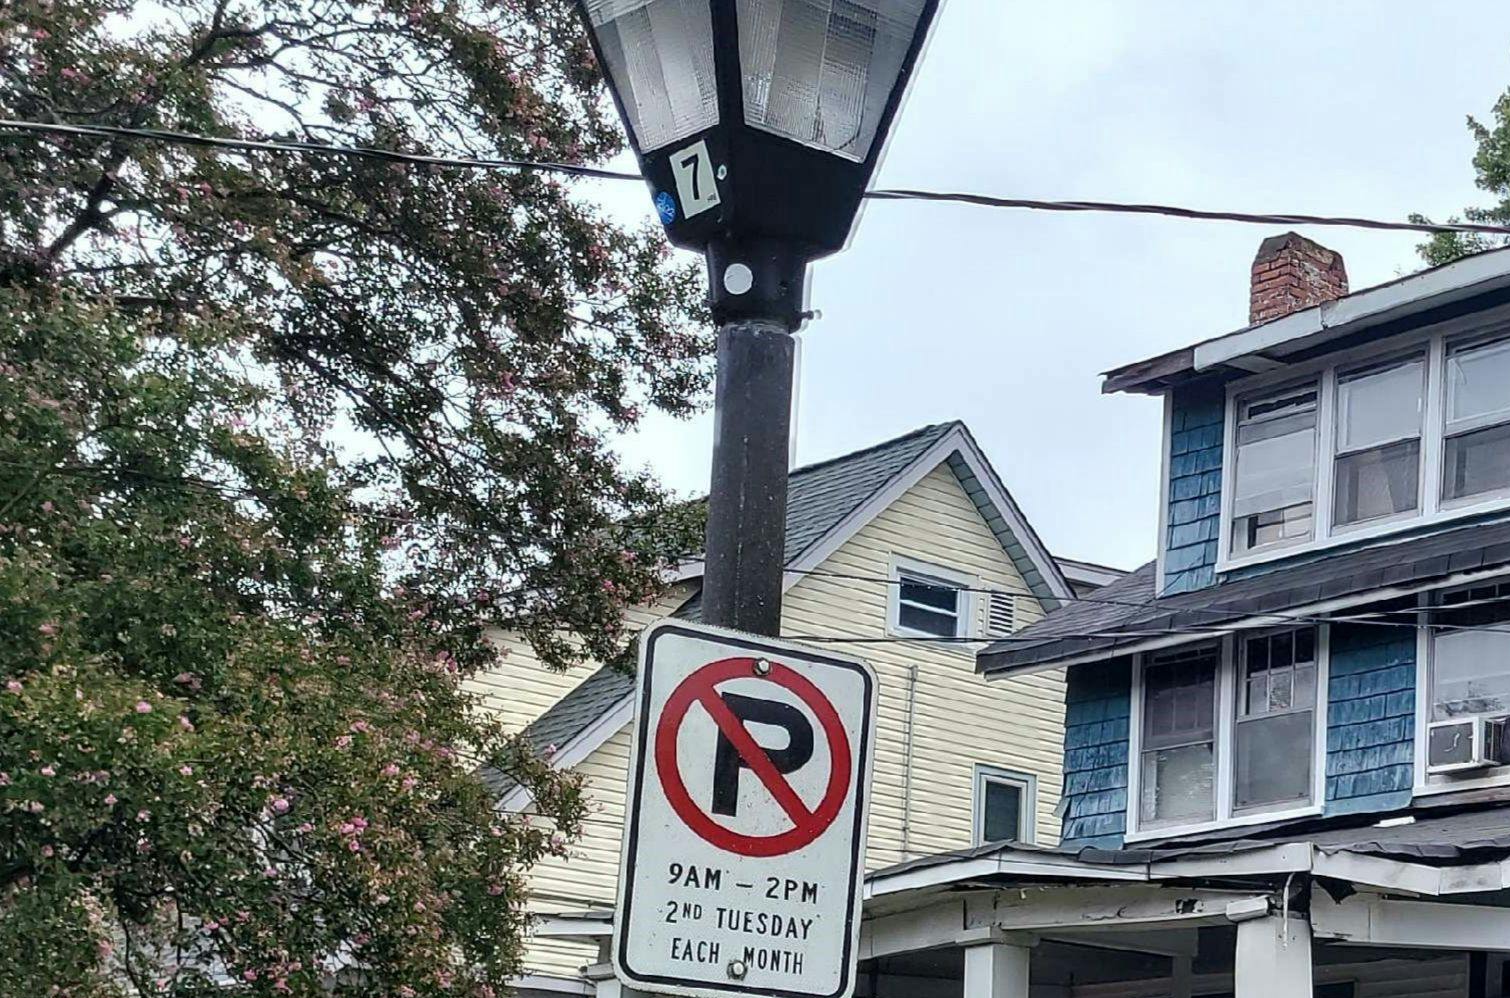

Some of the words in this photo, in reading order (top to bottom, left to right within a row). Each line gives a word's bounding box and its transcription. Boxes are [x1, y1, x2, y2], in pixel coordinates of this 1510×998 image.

[680, 153, 700, 201] 7
[668, 863, 722, 891] 9AM
[765, 876, 818, 905] 2PM
[665, 900, 703, 924] 2ND
[716, 907, 814, 940] TUESDAY
[670, 937, 720, 965] EACH
[743, 946, 804, 976] MONTH
